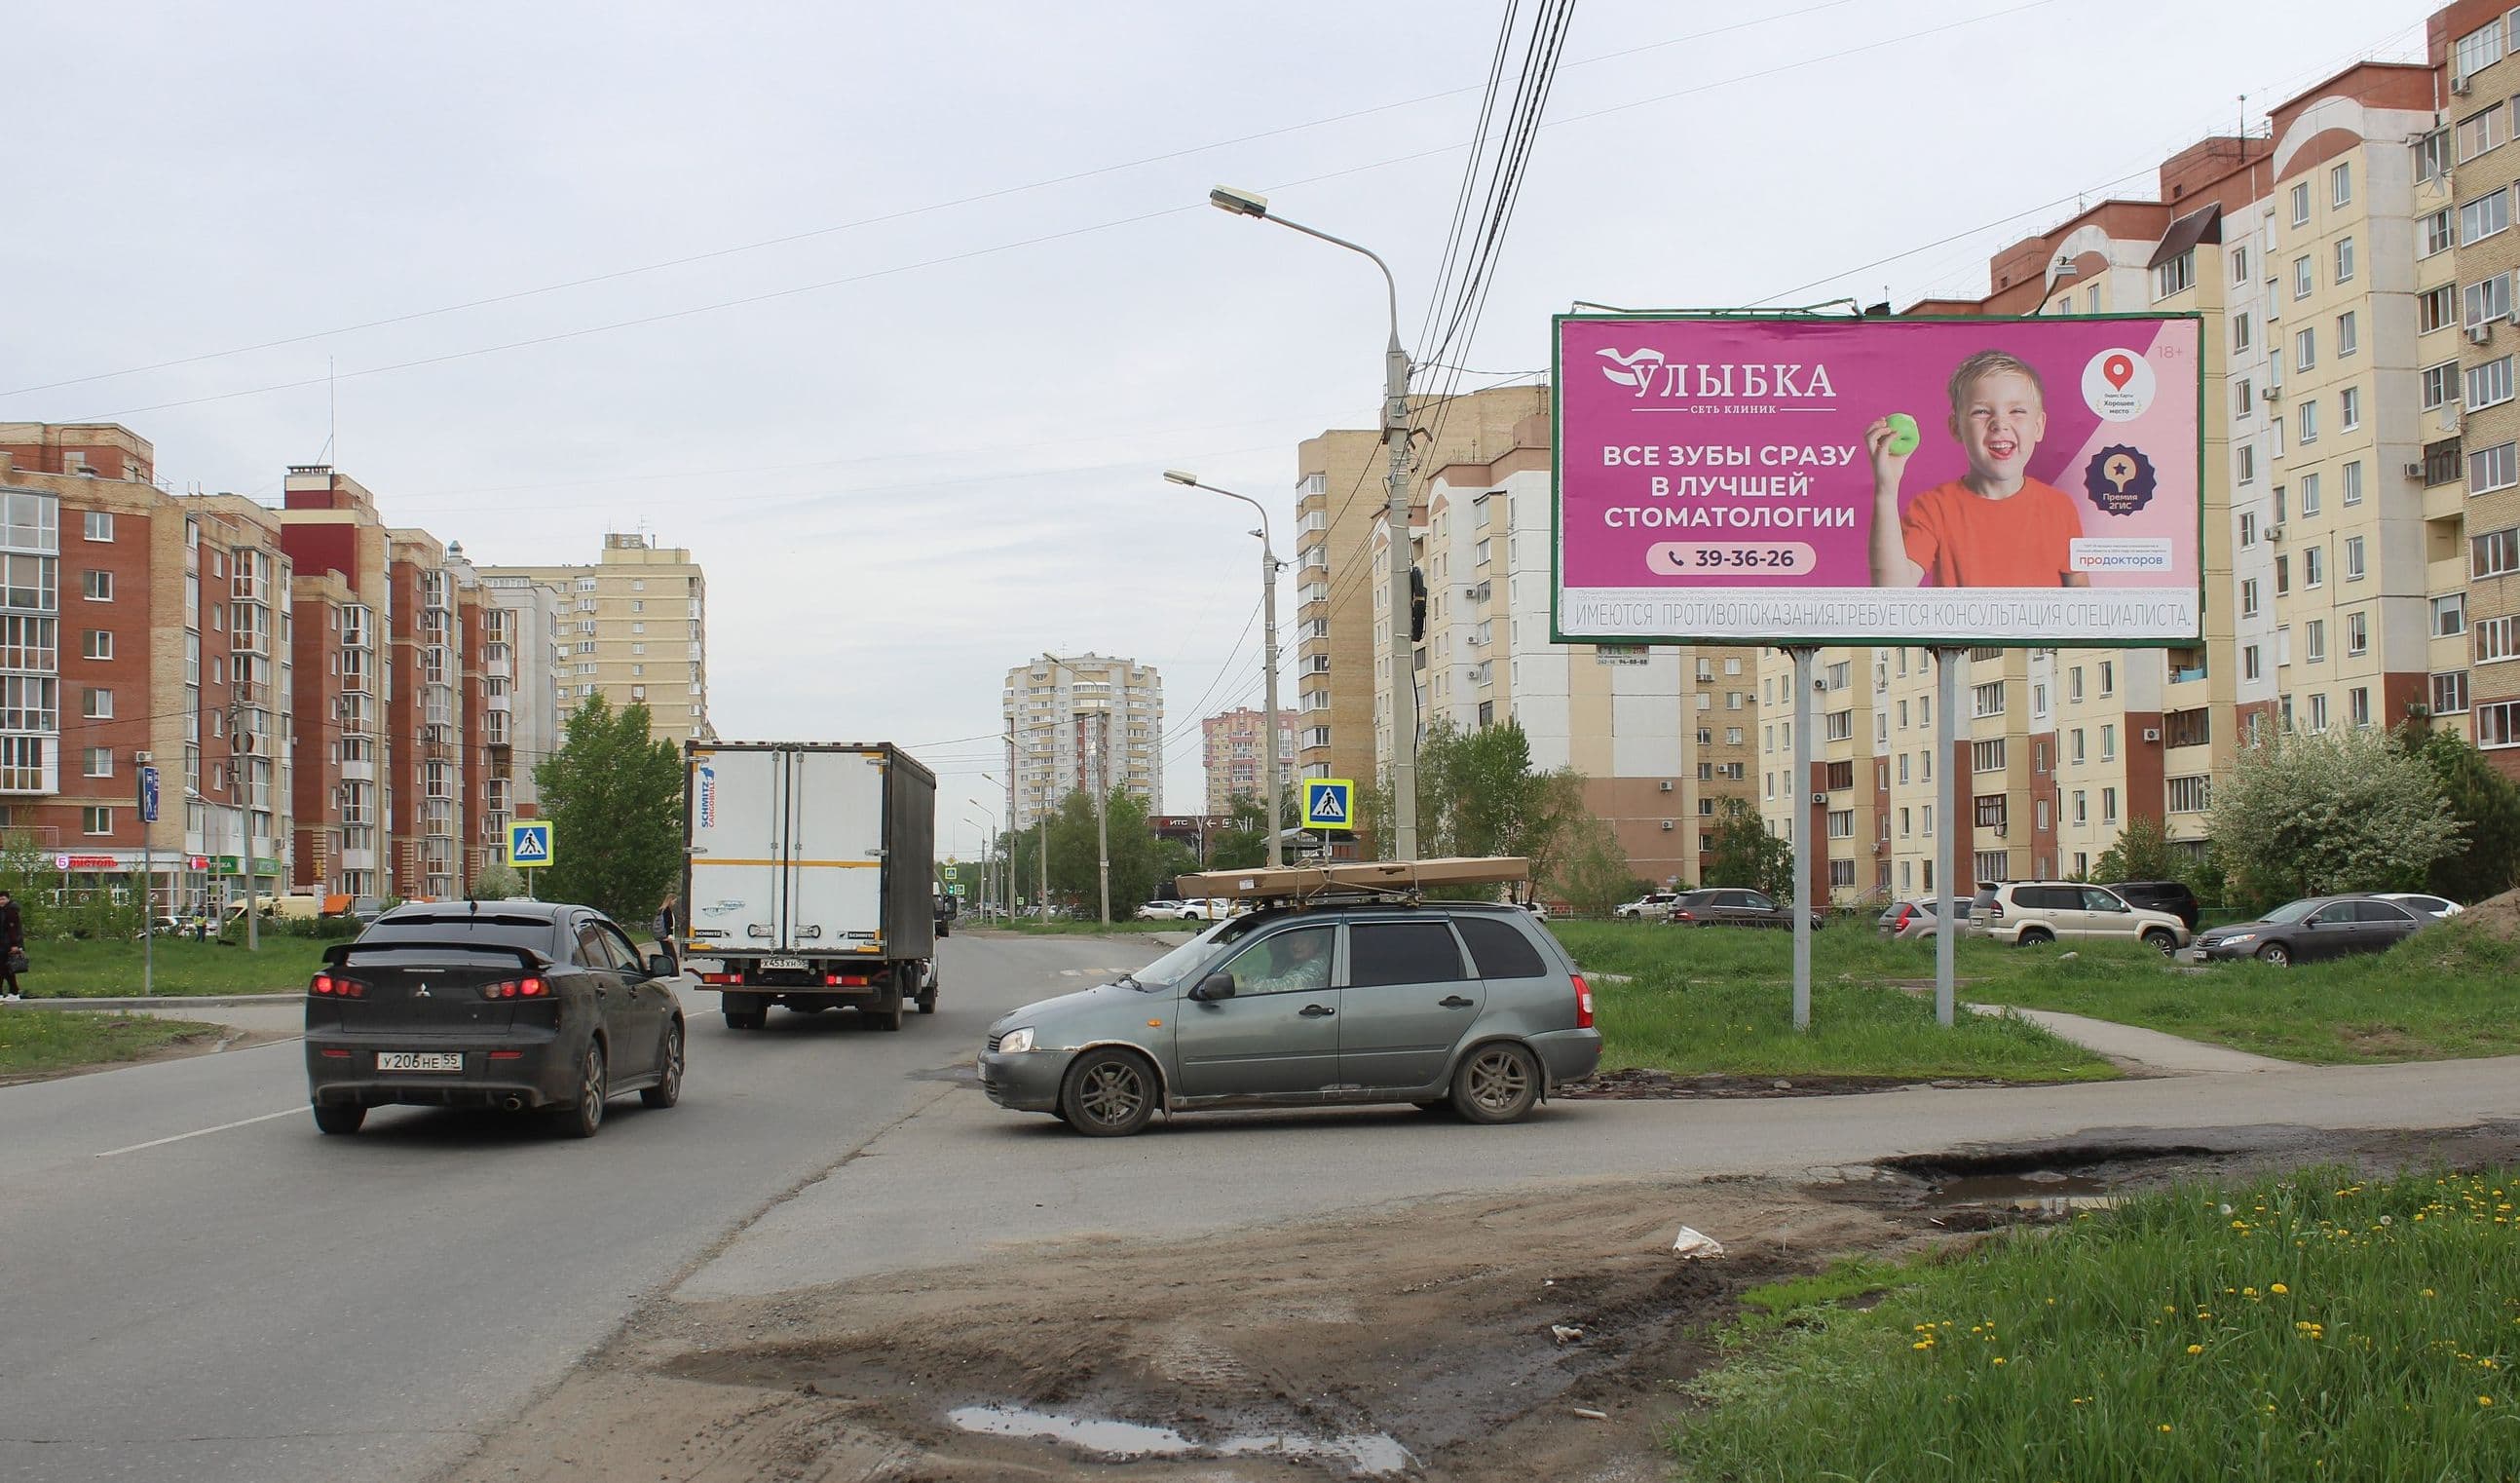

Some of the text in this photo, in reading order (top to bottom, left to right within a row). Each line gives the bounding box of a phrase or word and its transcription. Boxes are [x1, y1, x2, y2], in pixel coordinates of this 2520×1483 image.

[2157, 346, 2182, 359] 18+
[1631, 363, 1836, 398] УЛЫБКА
[1690, 405, 1777, 414] СЕТЬ КЛИНИК
[1603, 445, 1857, 466] ВСЕ ЗУБЫ СРАЗУ
[1651, 476, 1670, 497] В
[2103, 493, 2138, 502] Премия
[1604, 507, 1856, 527] СТОМАТОЛОГИИ
[1695, 550, 1794, 567] 39-36-26
[2080, 556, 2163, 567] продокторов
[1576, 603, 1653, 626] ИМЕЮТСЯ
[1935, 603, 2061, 629] КОНСУЛЬТАЦИЯ
[2066, 603, 2191, 629] СПЕЦИАЛИСТА.
[443, 1054, 458, 1065] 55
